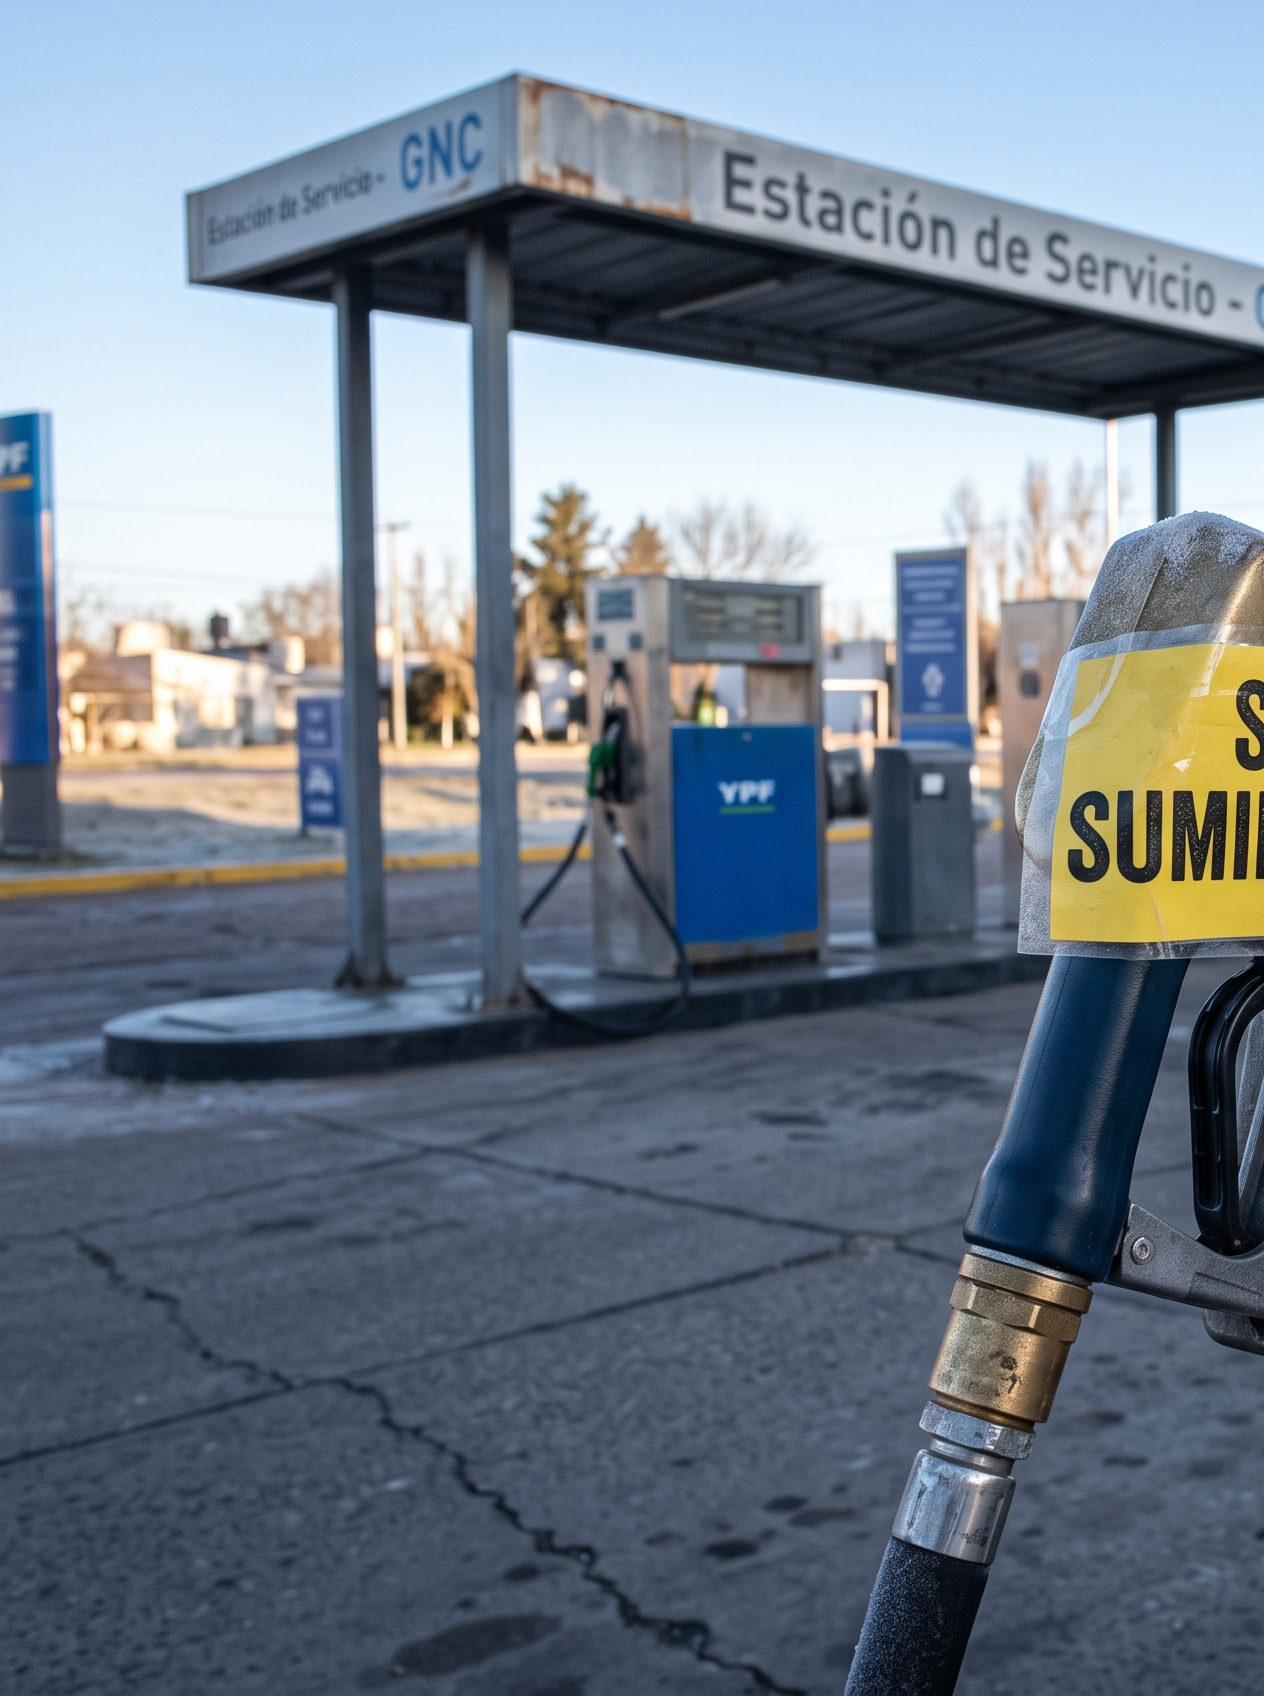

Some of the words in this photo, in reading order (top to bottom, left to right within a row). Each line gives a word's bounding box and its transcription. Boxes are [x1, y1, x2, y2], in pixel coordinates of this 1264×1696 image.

[401, 112, 482, 192] GNC
[723, 150, 957, 260] Estación
[975, 214, 1030, 276] de
[1045, 231, 1216, 317] Servicio
[718, 779, 776, 805] YPF
